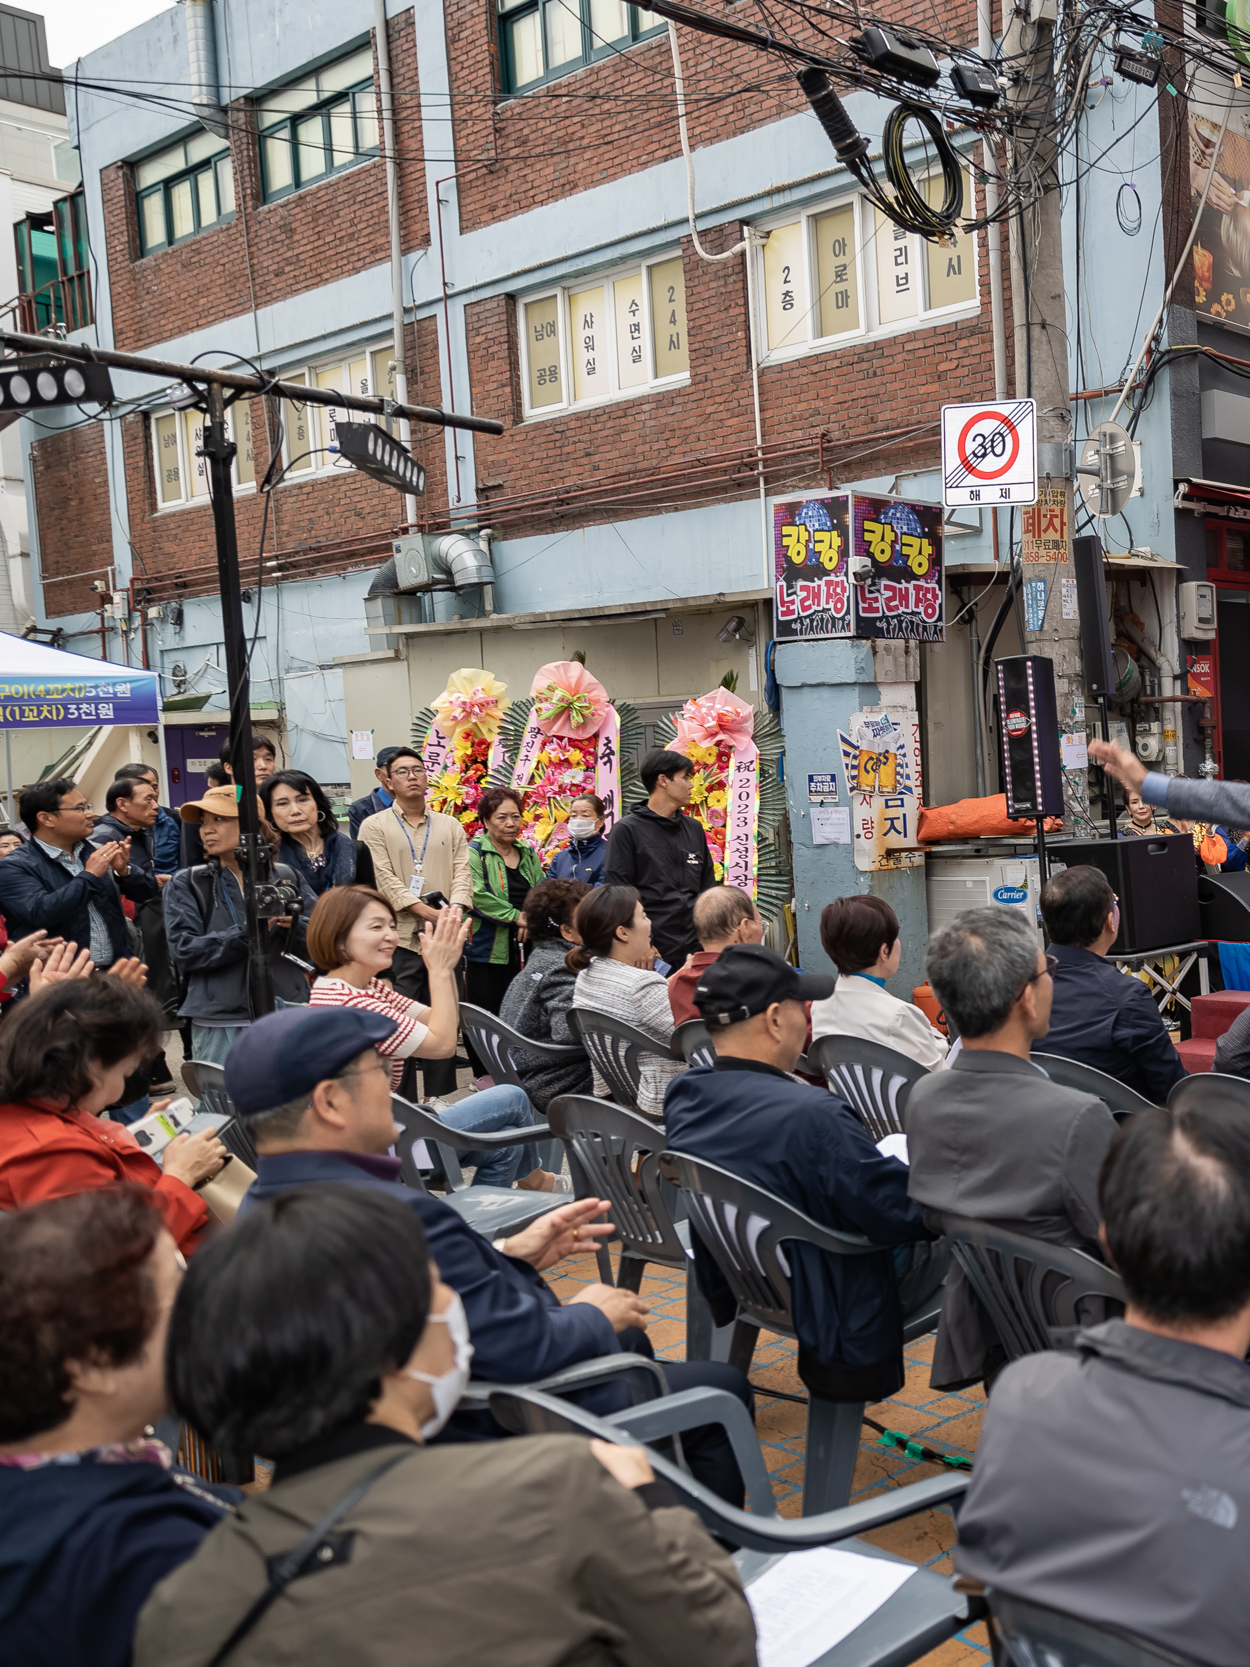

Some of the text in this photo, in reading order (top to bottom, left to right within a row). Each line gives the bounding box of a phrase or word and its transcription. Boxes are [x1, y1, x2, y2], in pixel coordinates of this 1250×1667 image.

[781, 264, 795, 312] 2층
[832, 236, 851, 310] 아로마
[533, 320, 557, 343] 남여
[628, 298, 643, 365] 수면실
[666, 285, 681, 352] 24시
[583, 312, 597, 377] 샤워실
[536, 364, 559, 387] 공용
[971, 432, 1007, 458] 30
[969, 486, 1011, 502] 해 제
[1022, 507, 1067, 540] 폐차
[782, 523, 842, 572] 캉캉
[863, 519, 933, 577] 캉캉
[778, 577, 848, 621] 노래짱
[858, 581, 941, 622] 노래짱
[85, 682, 132, 697] 5천원
[67, 703, 115, 720] 3천원
[734, 759, 756, 774] 祝
[863, 749, 890, 776] Cass
[736, 777, 751, 828] 2023
[809, 782, 836, 792] 주차금지
[729, 833, 755, 888] 신성시장
[997, 889, 1024, 900] Carrier
